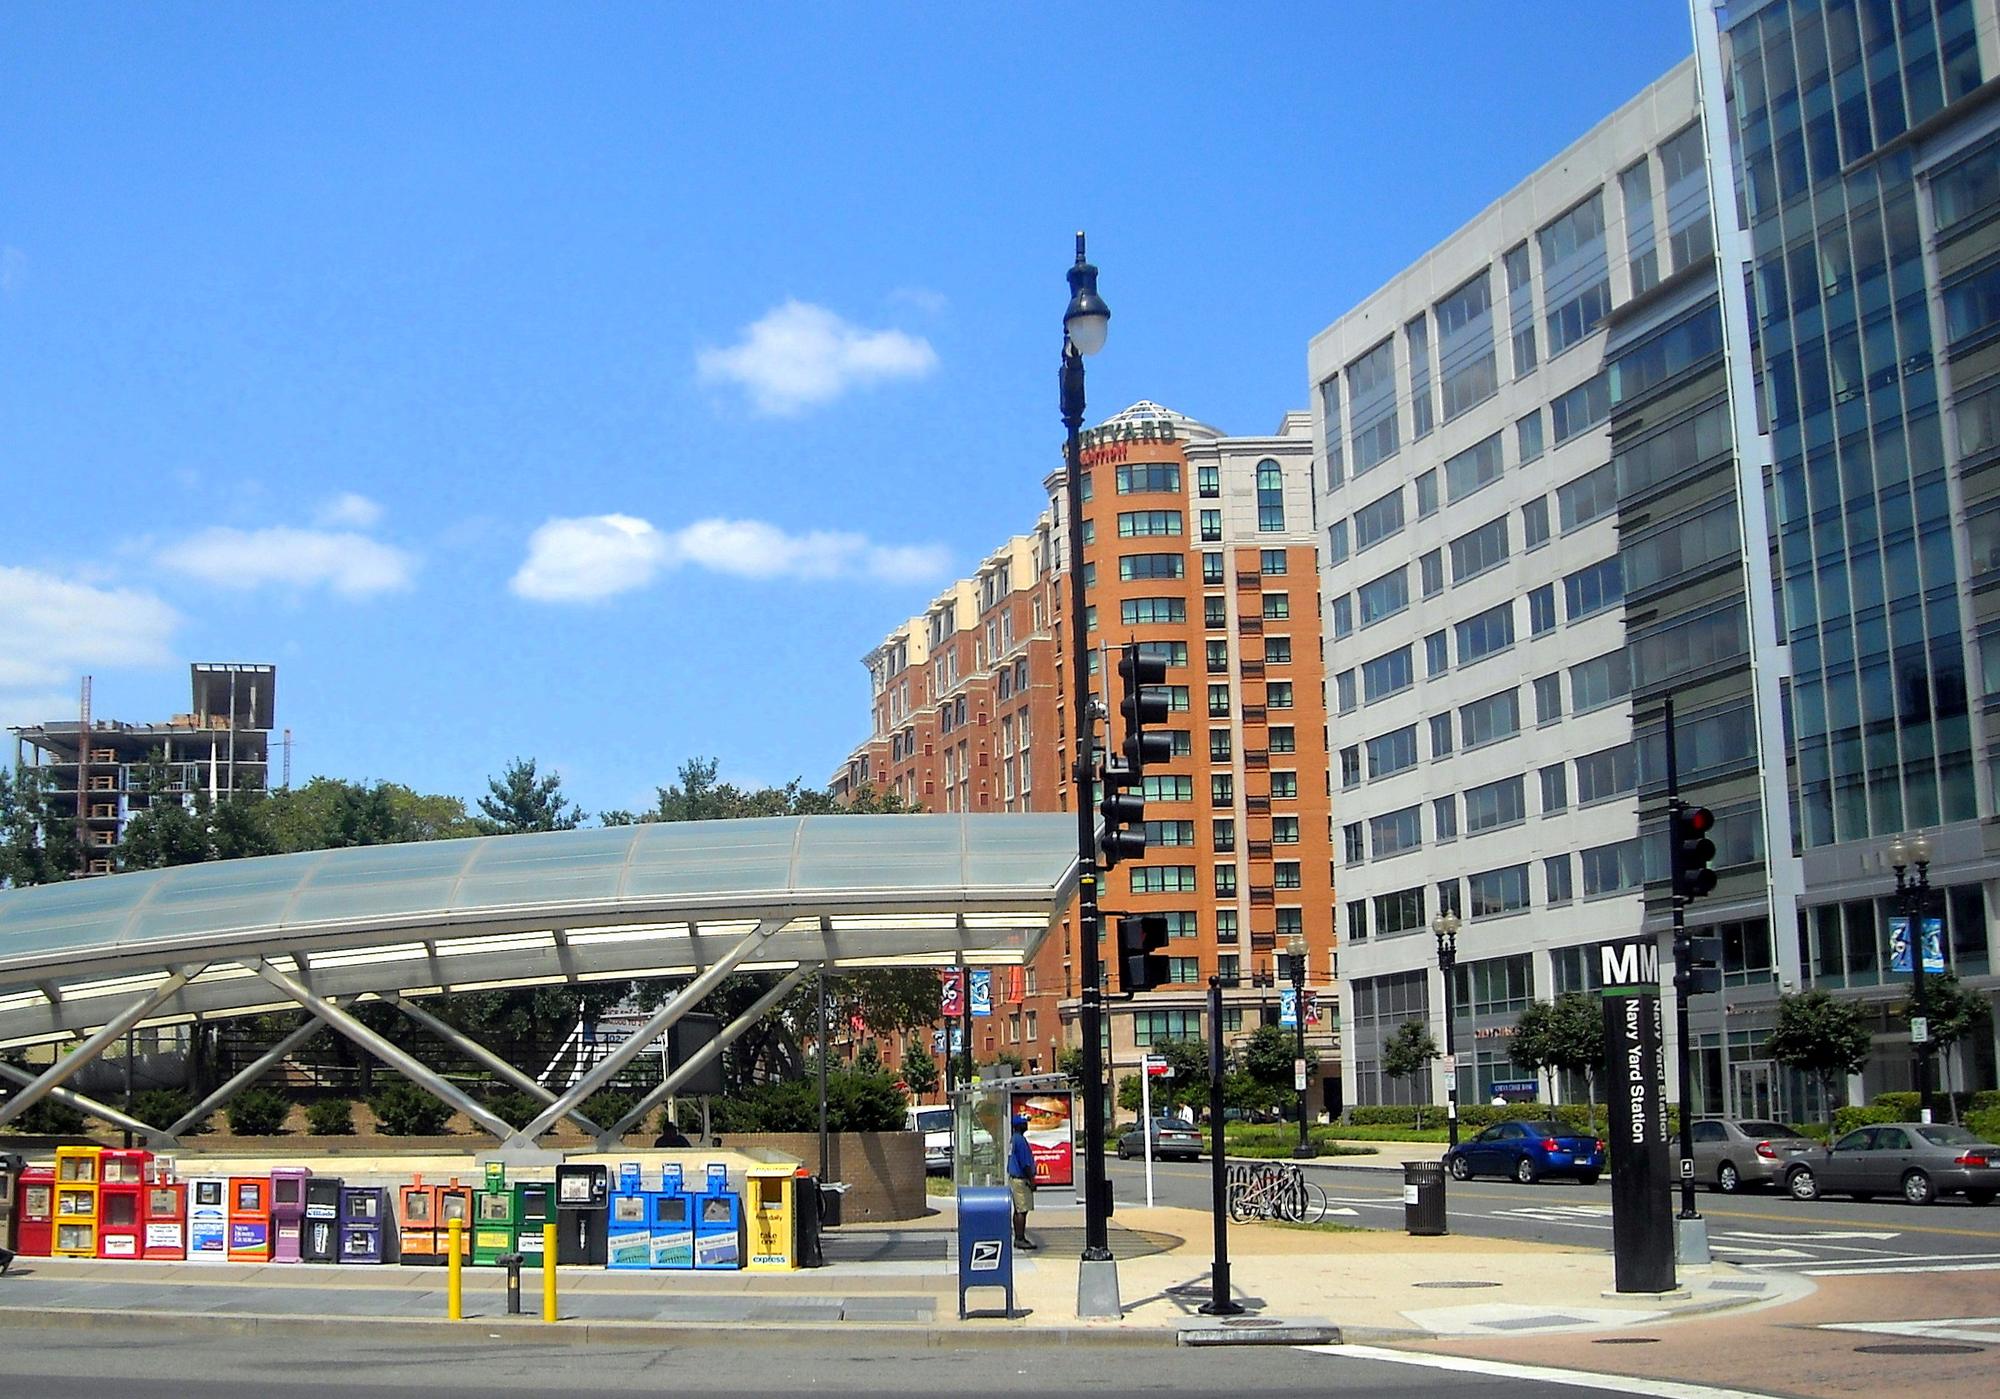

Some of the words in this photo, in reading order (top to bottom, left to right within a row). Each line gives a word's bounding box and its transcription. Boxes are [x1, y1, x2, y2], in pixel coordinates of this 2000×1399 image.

[1601, 944, 1639, 985] M
[1640, 944, 1659, 983] M
[1625, 999, 1640, 1040] Navy
[1652, 1000, 1662, 1040] Navy
[1628, 1044, 1643, 1081] Yard
[1655, 1045, 1665, 1080] Yard
[1630, 1085, 1646, 1144] Station
[1658, 1085, 1668, 1142] Station
[753, 1256, 786, 1265] express
